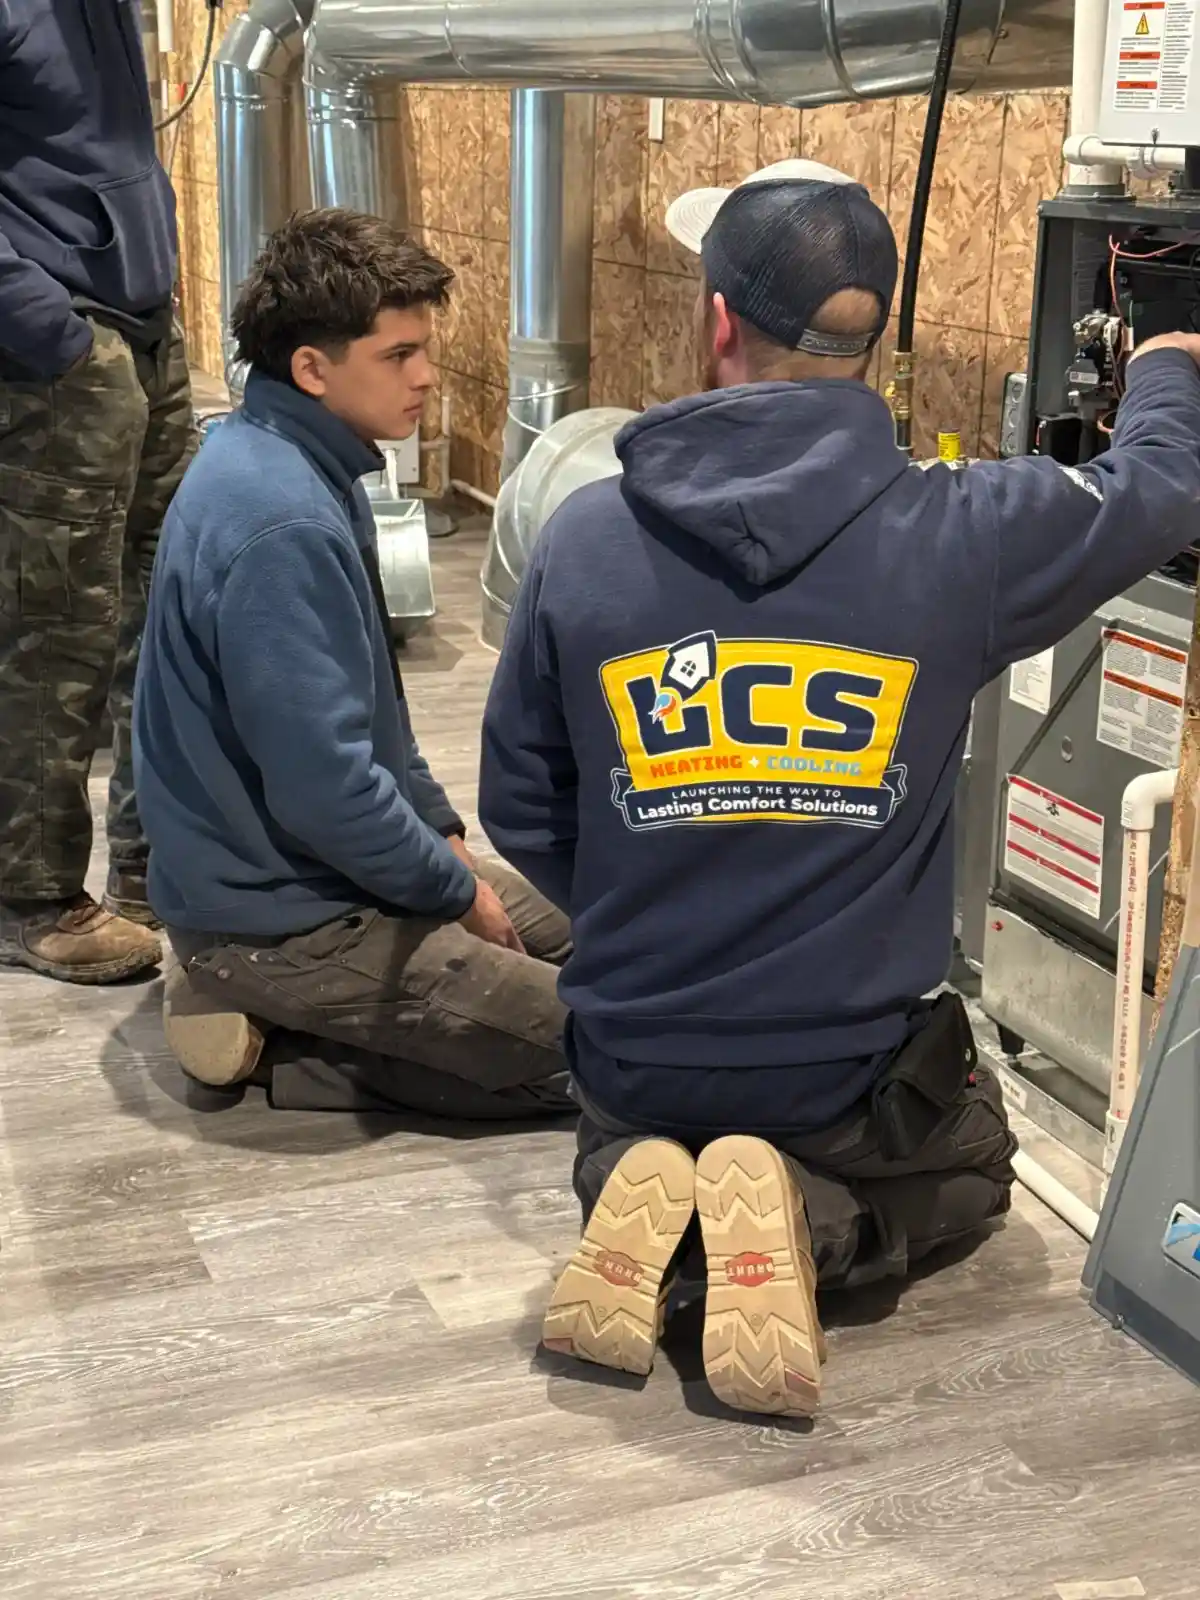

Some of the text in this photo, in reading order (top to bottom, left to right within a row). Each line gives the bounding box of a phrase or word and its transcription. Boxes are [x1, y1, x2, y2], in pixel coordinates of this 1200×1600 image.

[625, 663, 884, 757] LCS
[650, 755, 861, 778] HEATING COOLING
[672, 786, 841, 799] LAUNCHING THE WAY TO
[637, 797, 878, 819] Lasting Comfort Solutions
